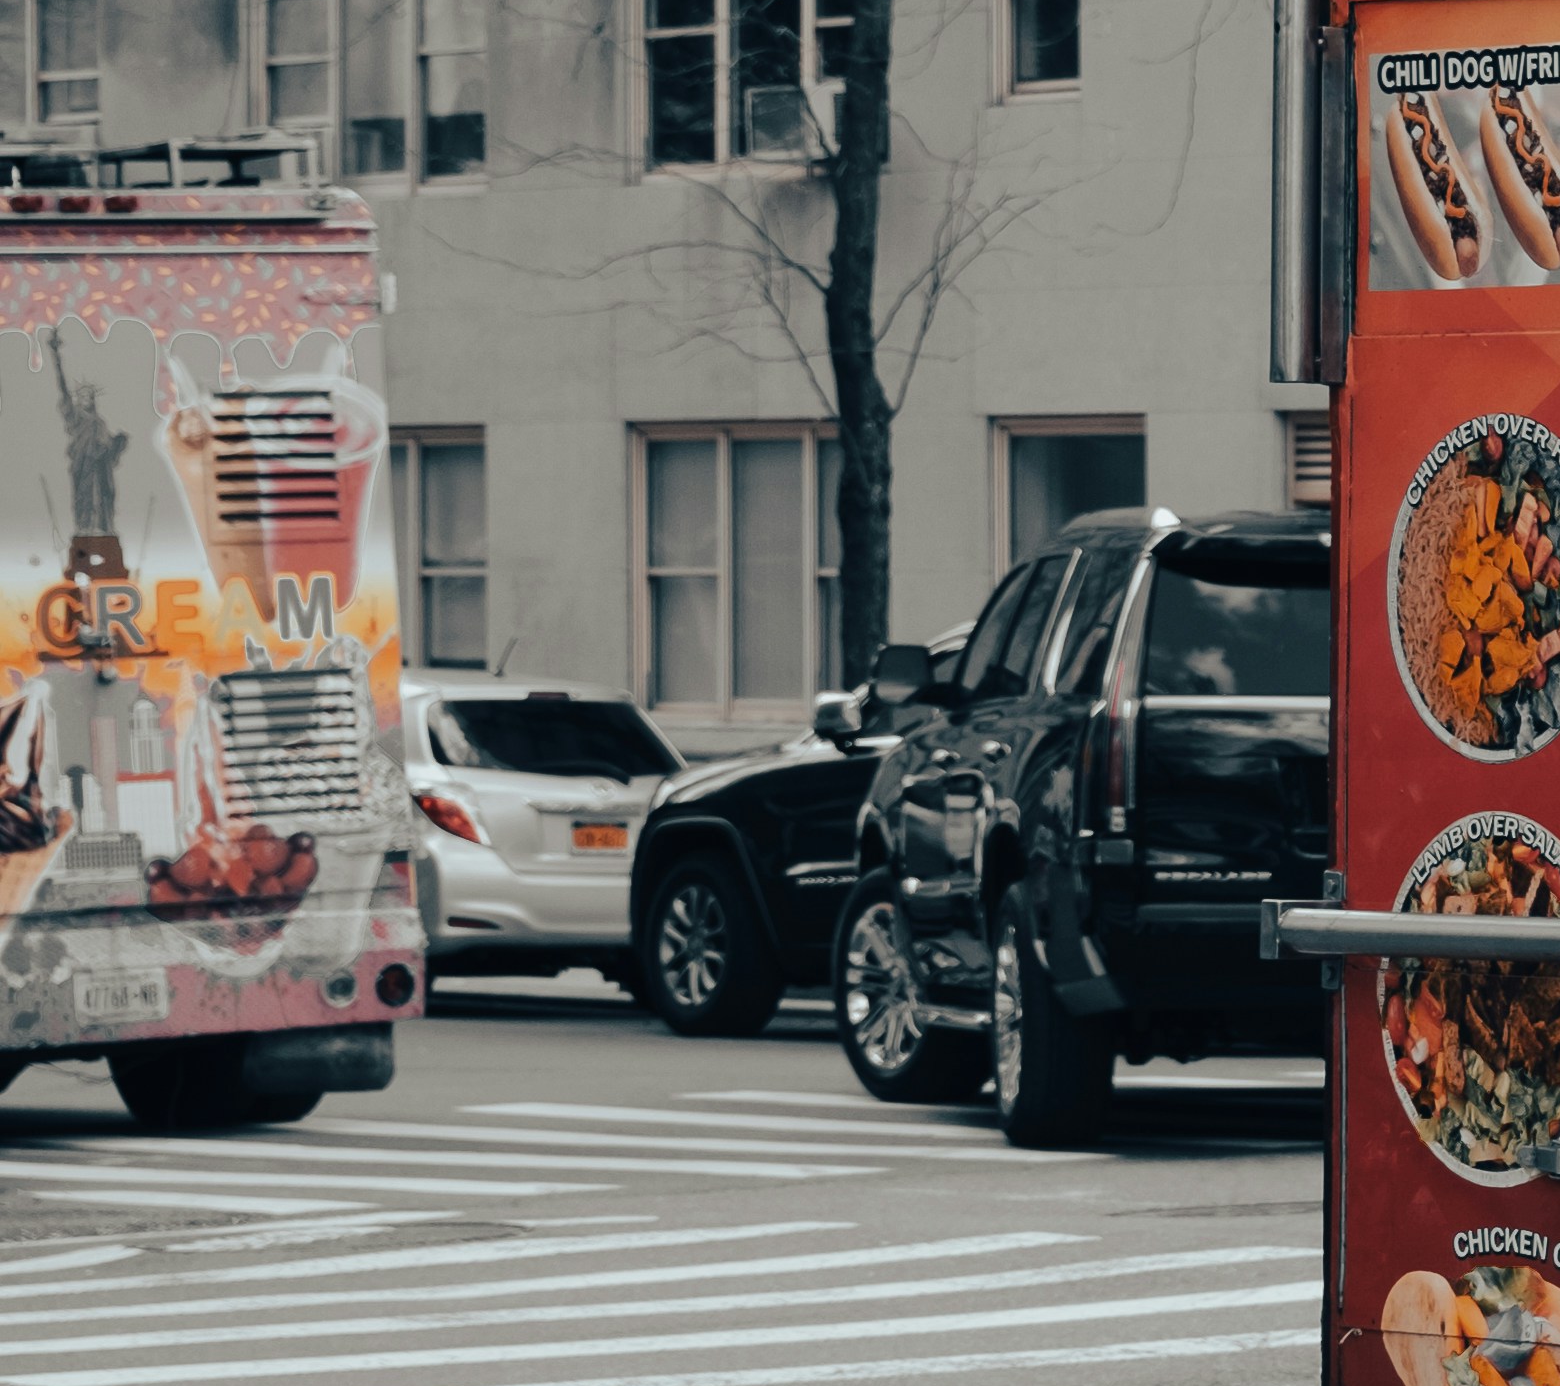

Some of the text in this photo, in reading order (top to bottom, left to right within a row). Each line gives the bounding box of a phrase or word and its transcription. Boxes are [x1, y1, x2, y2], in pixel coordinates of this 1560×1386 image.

[35, 571, 337, 658] CREAM
[1412, 827, 1462, 884] LAMB
[1467, 815, 1518, 840] OVER
[1453, 1227, 1548, 1261] CHICKEN
